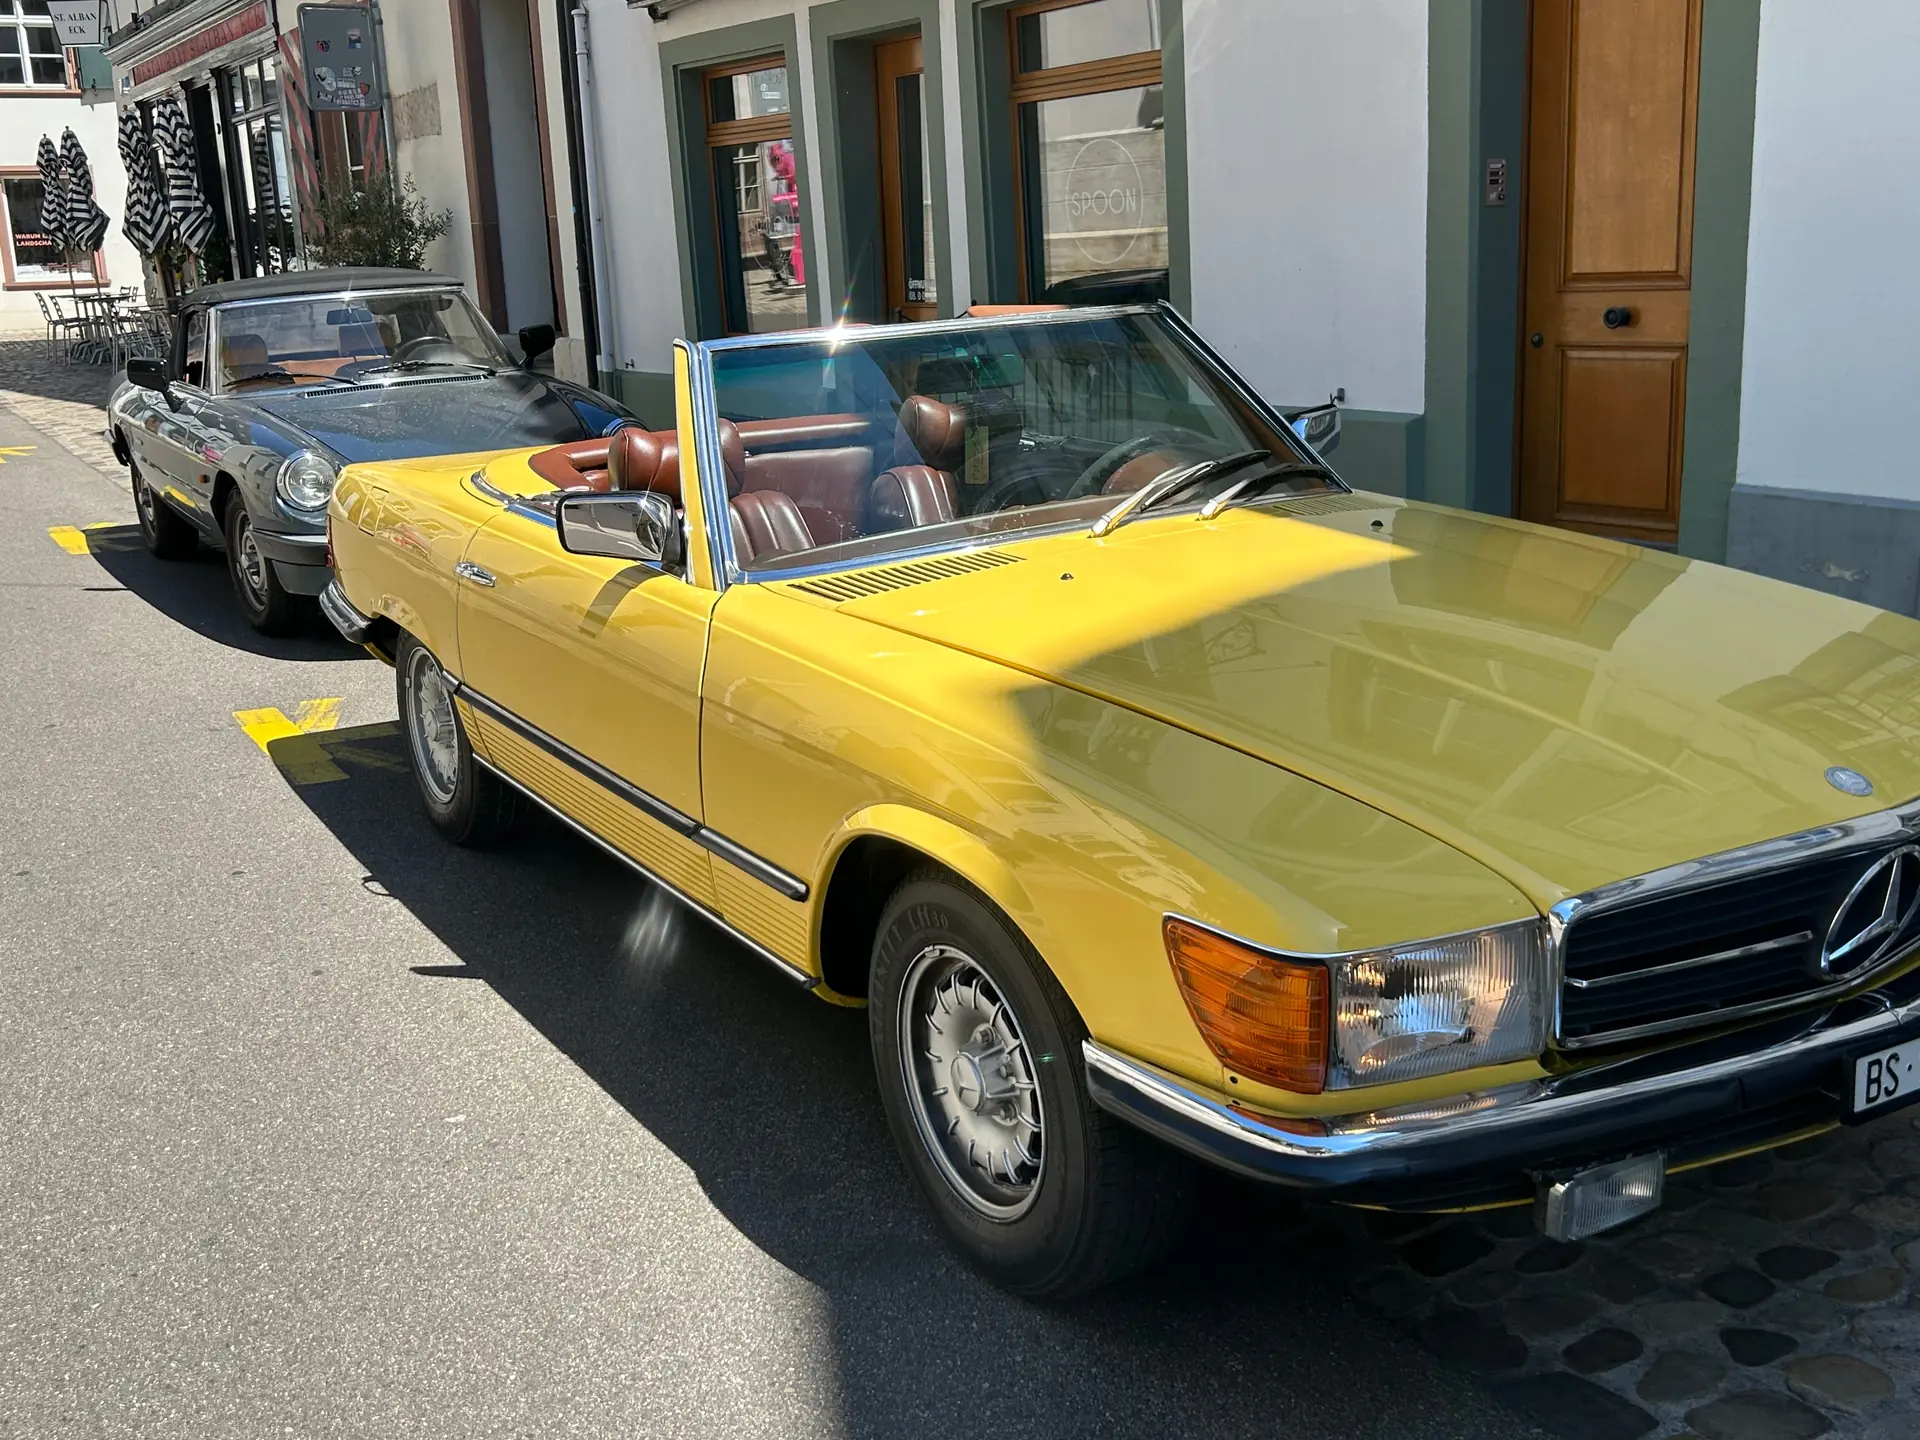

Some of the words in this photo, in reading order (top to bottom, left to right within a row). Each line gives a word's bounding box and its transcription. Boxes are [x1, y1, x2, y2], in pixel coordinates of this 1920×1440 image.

[53, 14, 66, 22] ST.
[68, 12, 97, 21] ALBAN
[68, 25, 86, 34] ECK
[1071, 187, 1136, 216] SPOON
